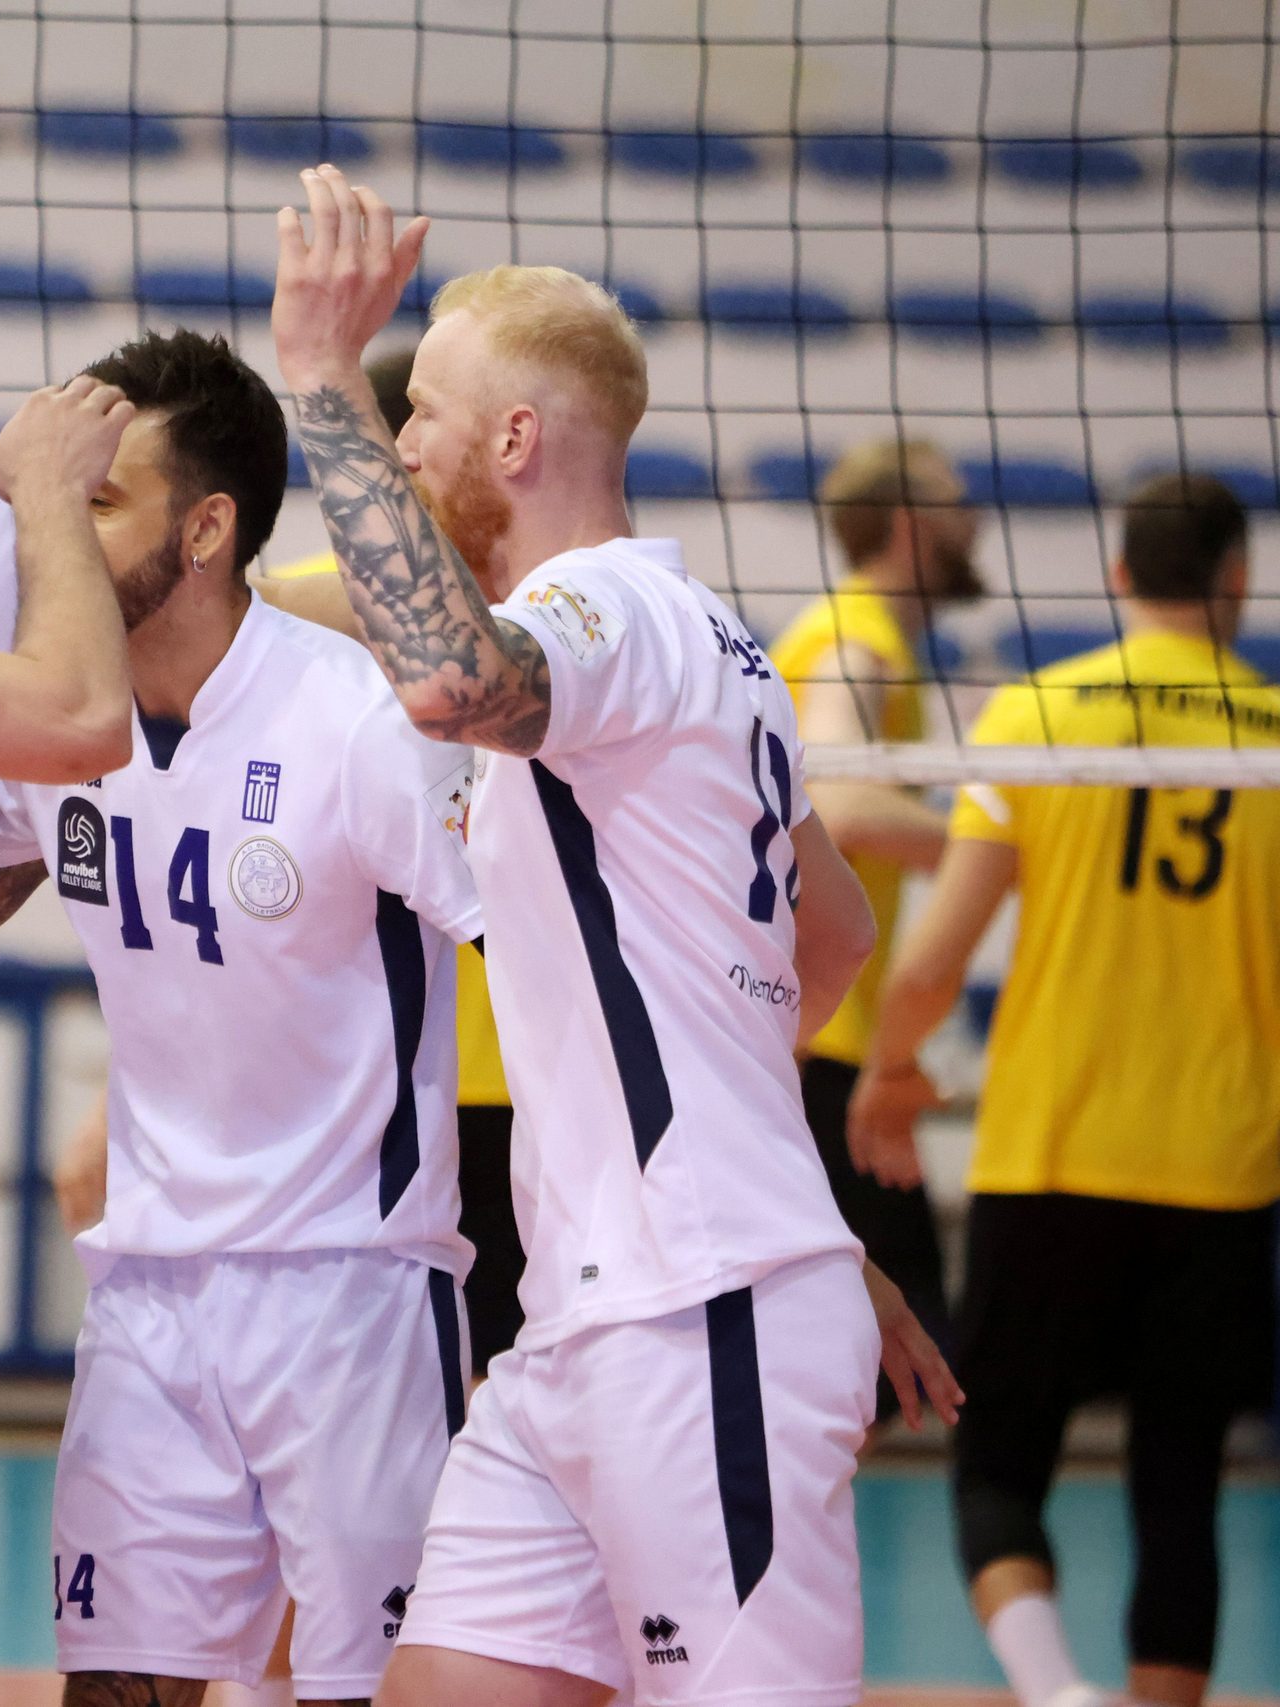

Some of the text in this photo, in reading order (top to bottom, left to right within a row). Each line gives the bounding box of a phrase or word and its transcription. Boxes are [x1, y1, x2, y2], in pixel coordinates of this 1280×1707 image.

[1123, 785, 1232, 898] 13
[60, 872, 102, 891] VOLLEY LEAGUE
[63, 862, 99, 880] novibet
[111, 815, 224, 967] 14
[54, 1553, 95, 1620] 14
[646, 1646, 689, 1664] errea
